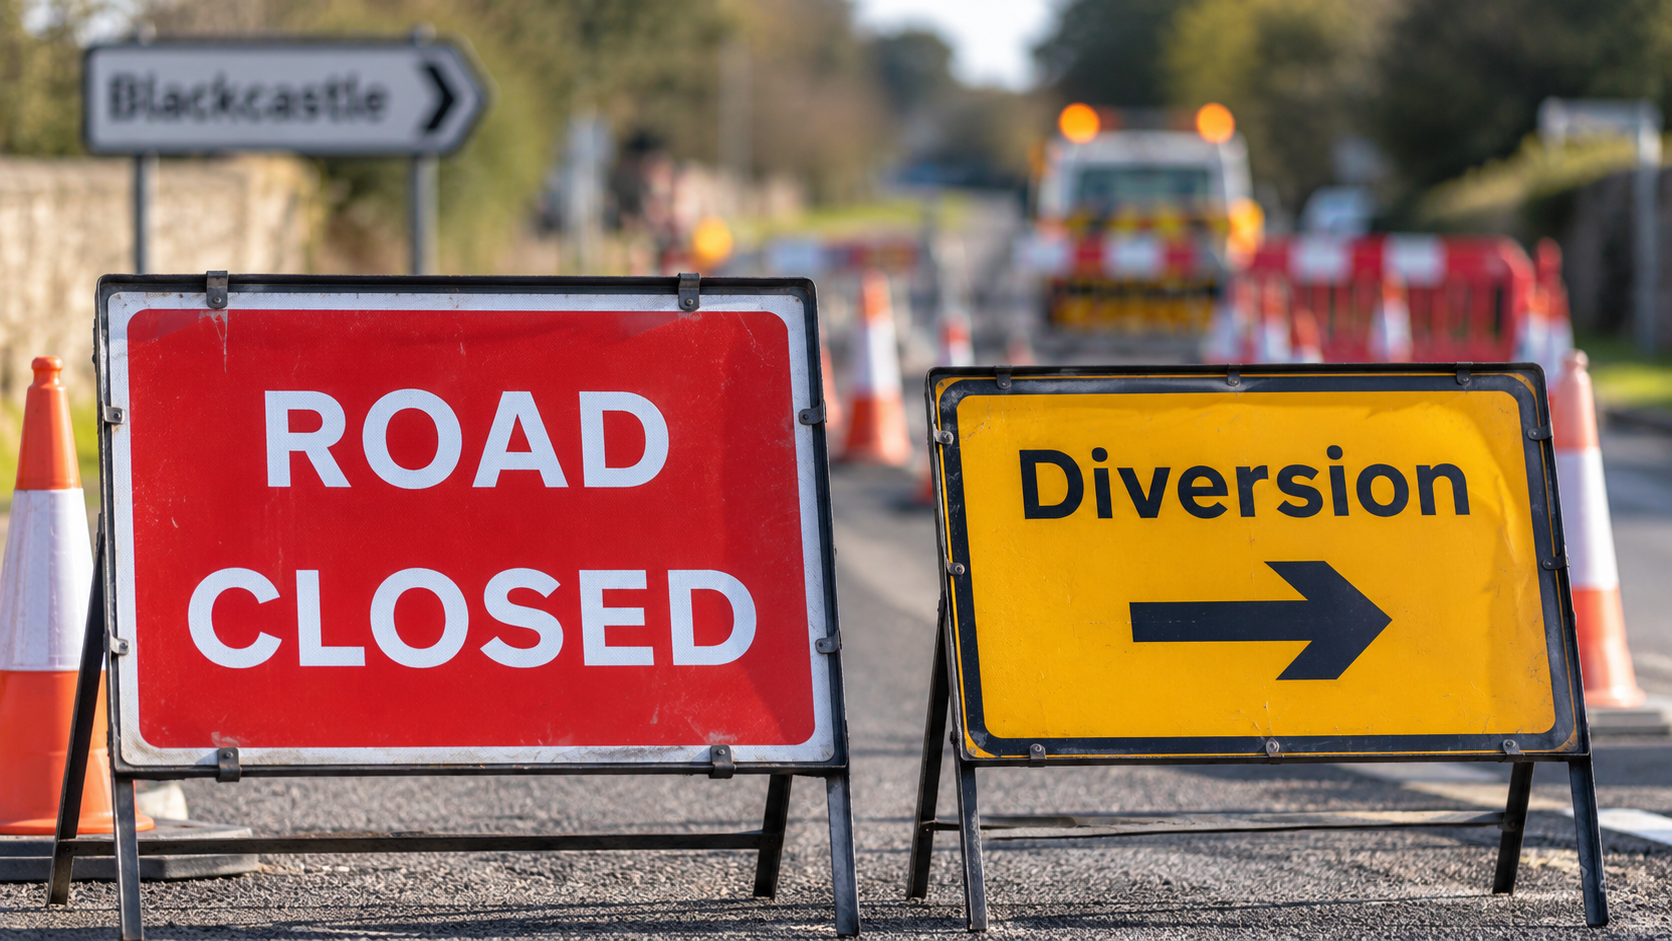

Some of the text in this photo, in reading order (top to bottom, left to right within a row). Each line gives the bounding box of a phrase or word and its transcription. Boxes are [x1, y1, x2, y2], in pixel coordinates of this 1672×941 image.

[108, 72, 388, 121] Blackcastle
[264, 388, 670, 490] ROAD
[1019, 445, 1471, 520] Diversion
[187, 567, 757, 669] CLOSED
